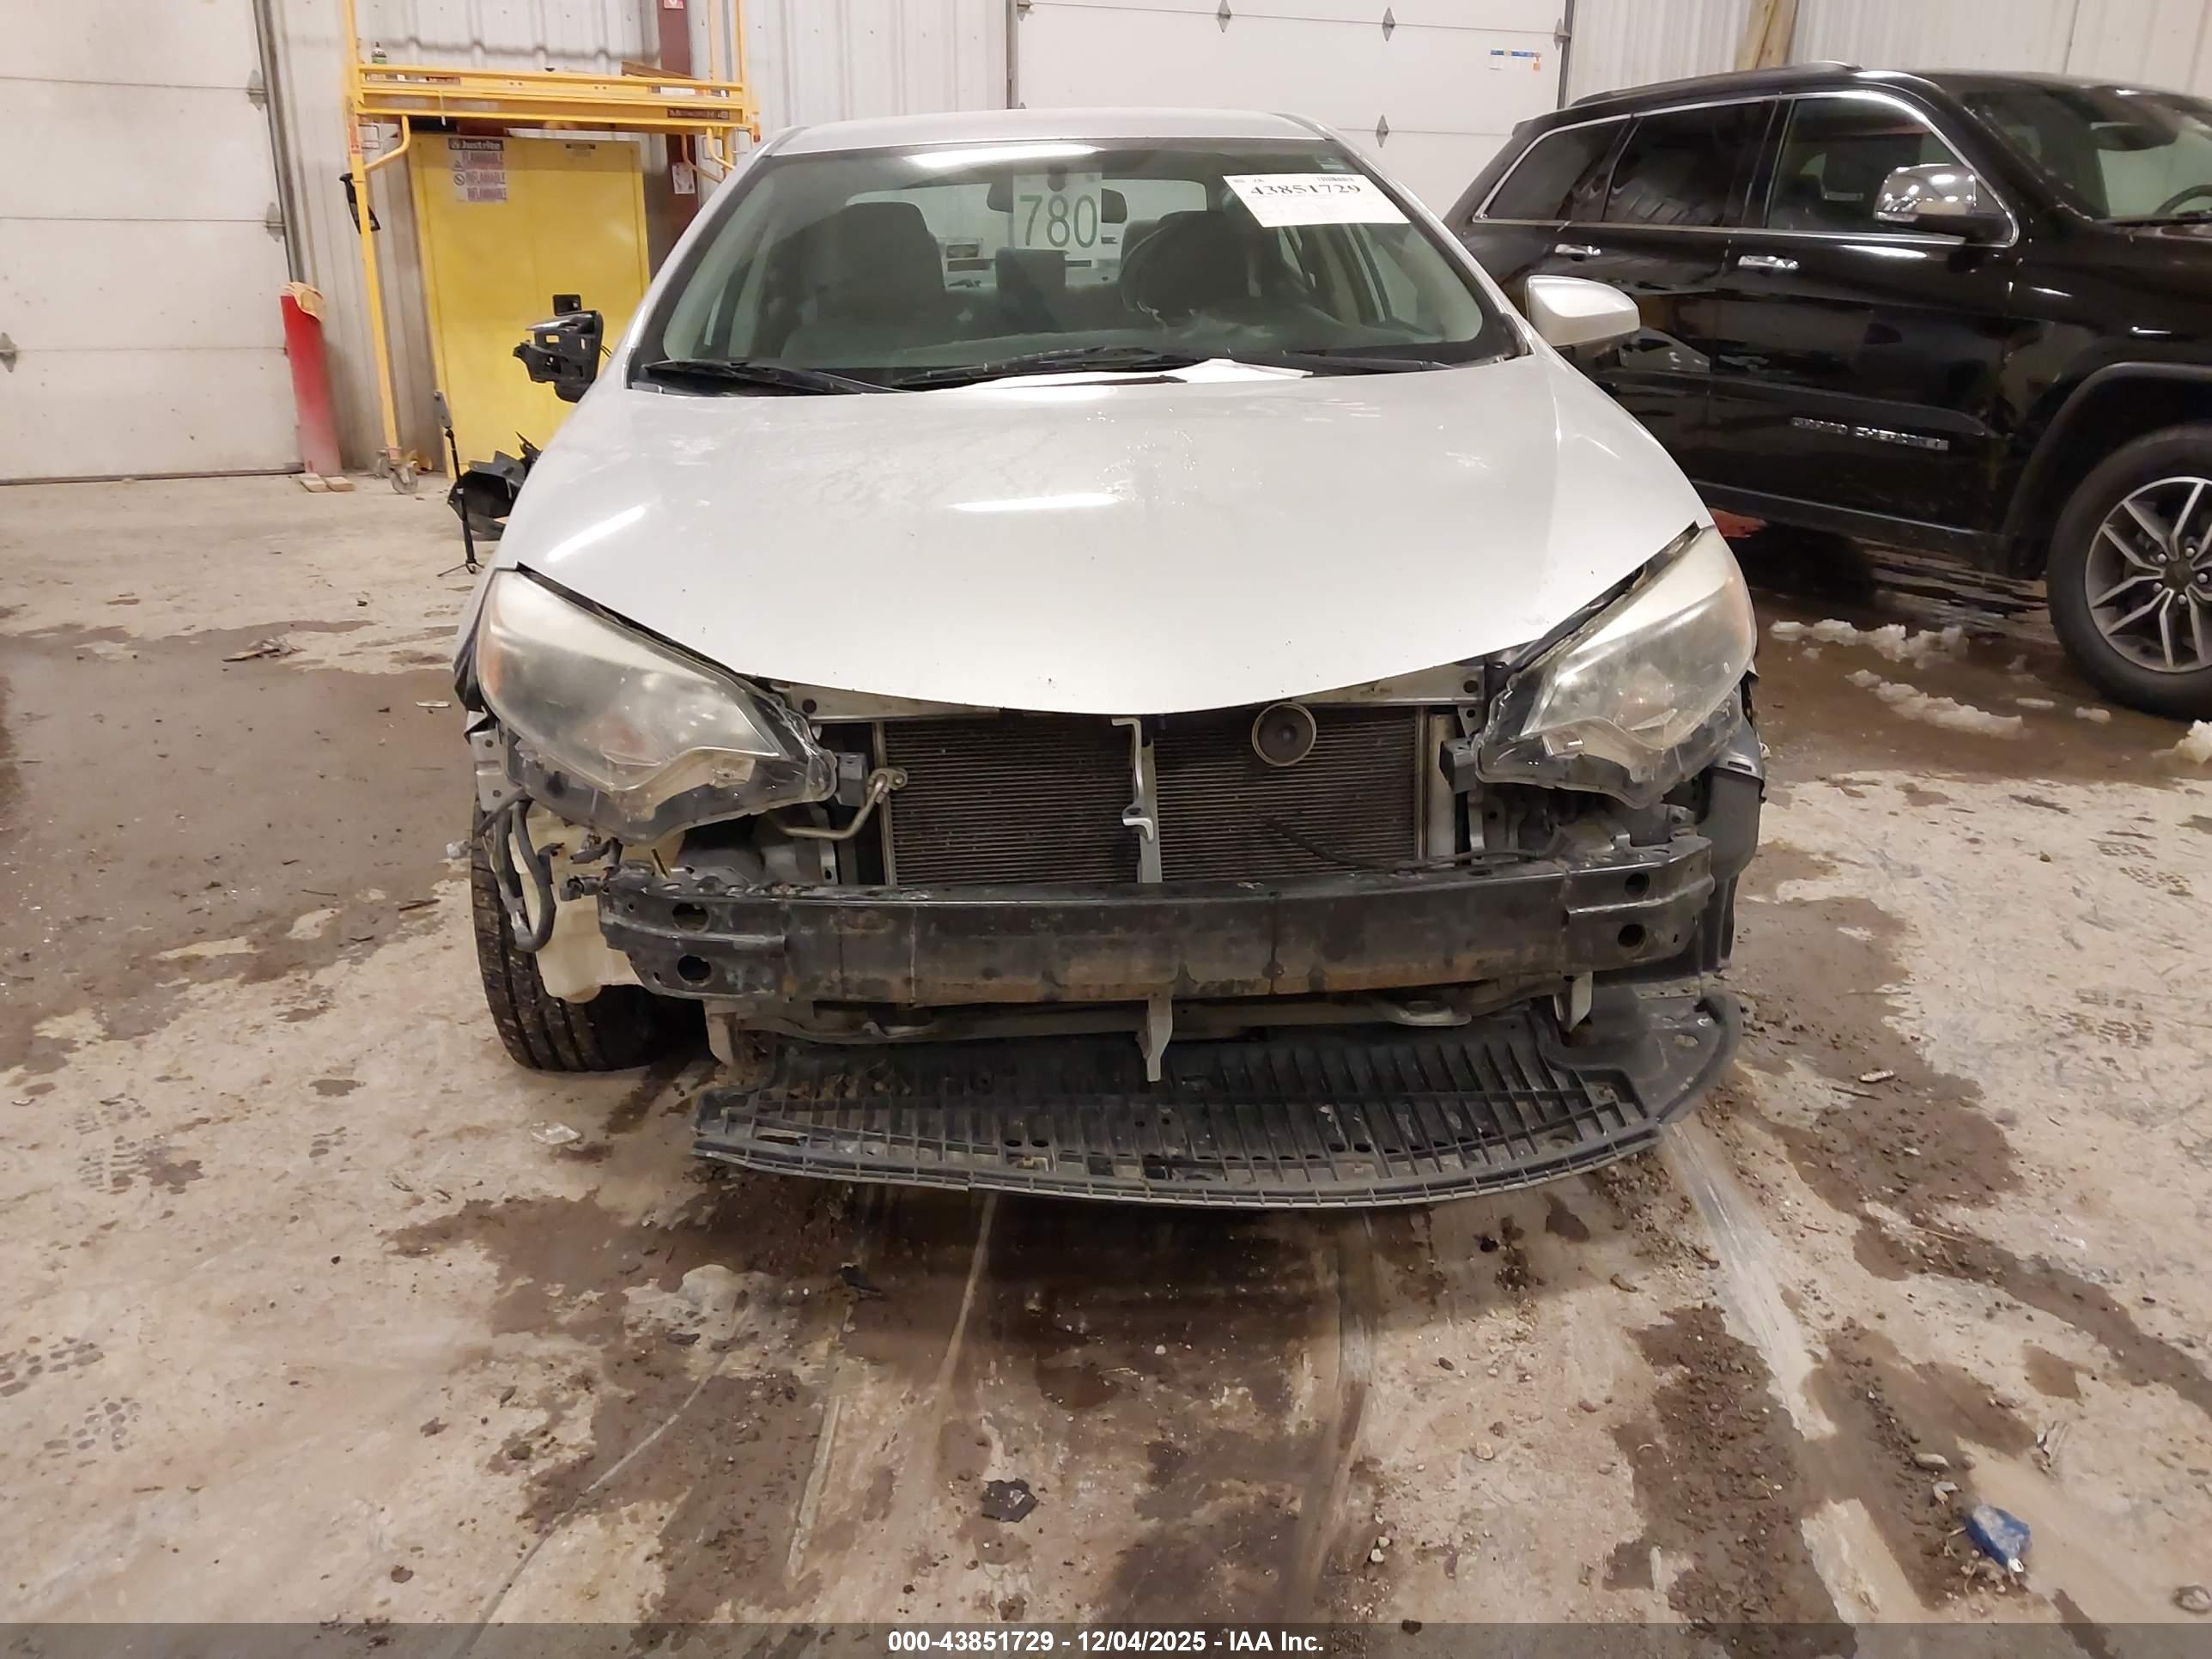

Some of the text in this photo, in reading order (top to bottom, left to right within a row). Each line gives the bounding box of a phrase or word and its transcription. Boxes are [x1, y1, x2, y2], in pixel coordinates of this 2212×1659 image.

[462, 140, 501, 149] Justrite
[1250, 184, 1362, 196] 43851729
[1019, 194, 1097, 248] 780
